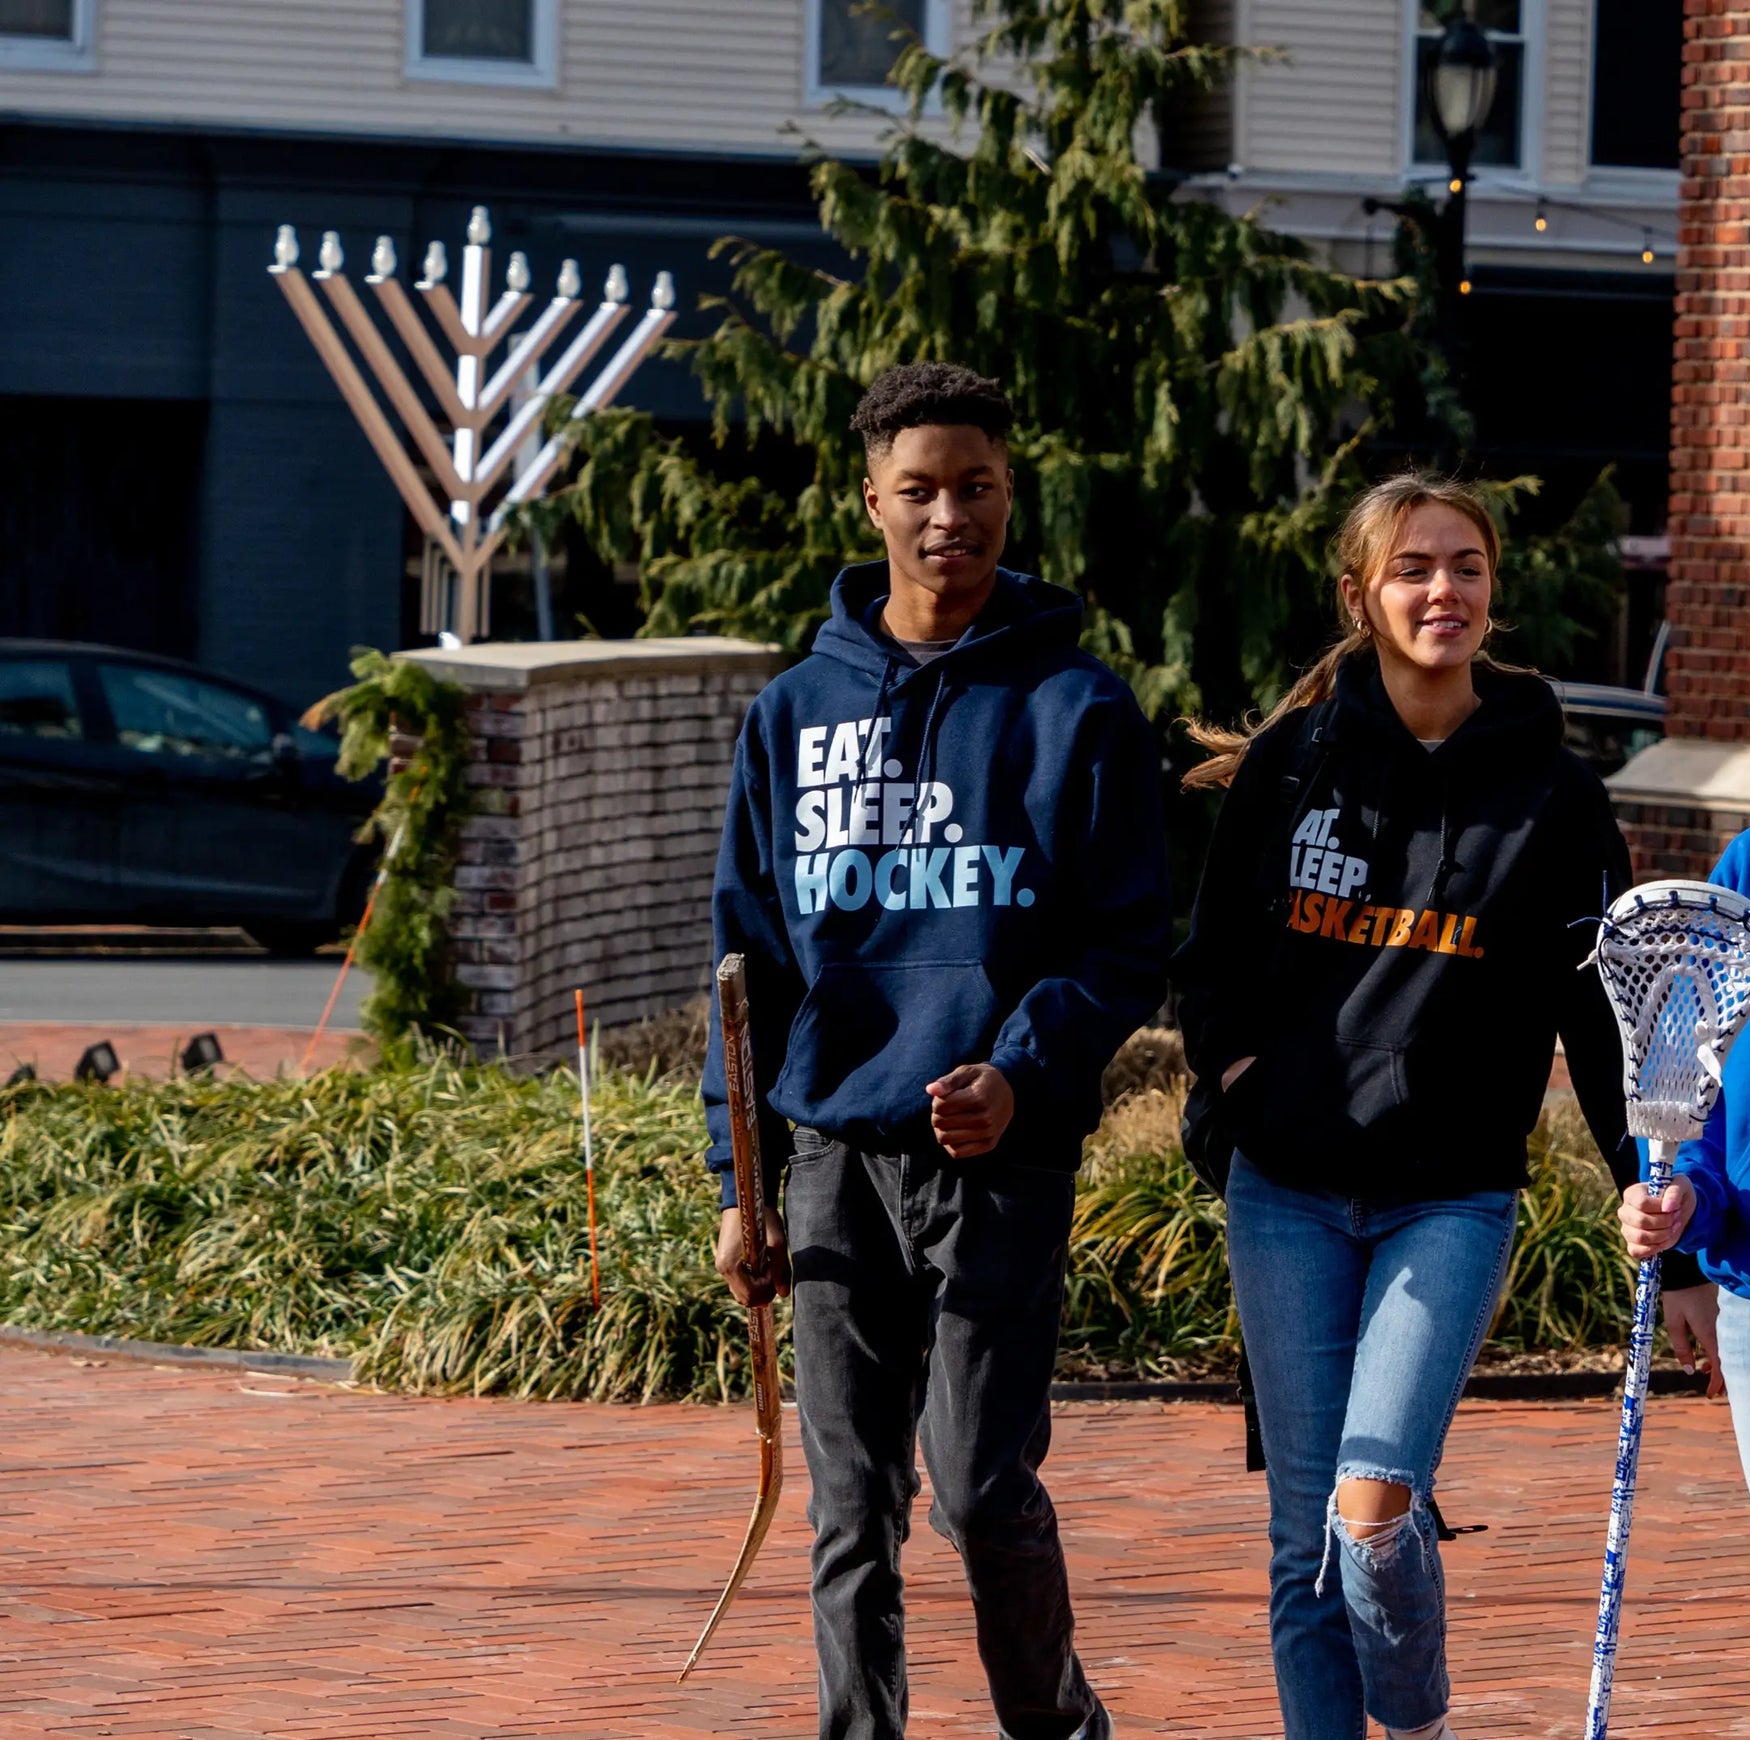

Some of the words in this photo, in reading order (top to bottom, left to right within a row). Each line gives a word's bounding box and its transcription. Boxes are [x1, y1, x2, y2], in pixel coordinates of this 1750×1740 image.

[797, 717, 903, 787] EAT.
[794, 781, 963, 852] SLEEP.
[1292, 809, 1340, 850] AT.
[794, 845, 1035, 914] HOCKEY.
[1290, 846, 1371, 901] LEEP.
[1287, 889, 1484, 958] ASKETBALL.
[726, 1034, 739, 1092] EASTON
[739, 1021, 756, 1130] EASTON
